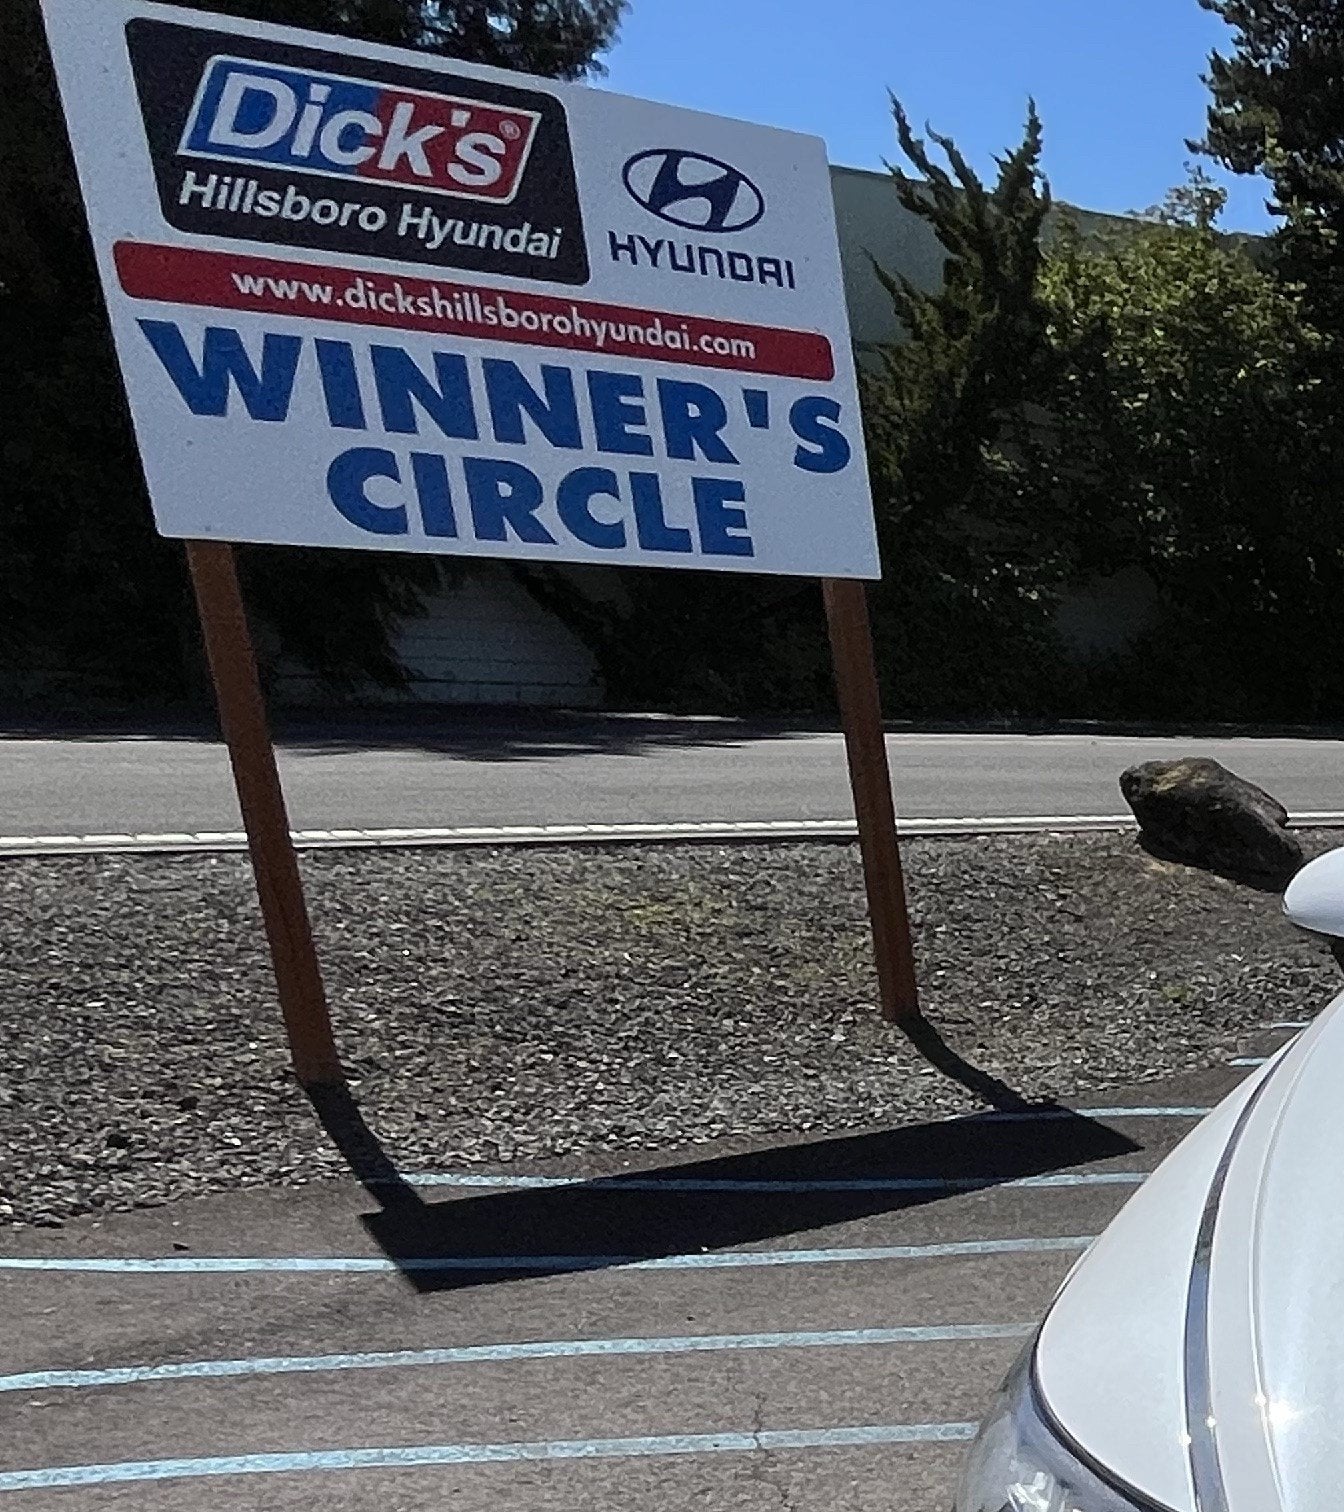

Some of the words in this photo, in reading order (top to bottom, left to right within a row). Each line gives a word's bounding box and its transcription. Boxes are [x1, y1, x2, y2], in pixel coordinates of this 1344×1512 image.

[207, 71, 506, 187] Dick's
[179, 170, 387, 232] Hillsboro
[399, 204, 562, 260] Hyundai
[609, 232, 796, 290] HYUNDAI
[231, 270, 757, 360] www.dickshillsborohyundai.com
[138, 319, 850, 474] WINNER'S
[326, 447, 755, 557] CIRCLE
